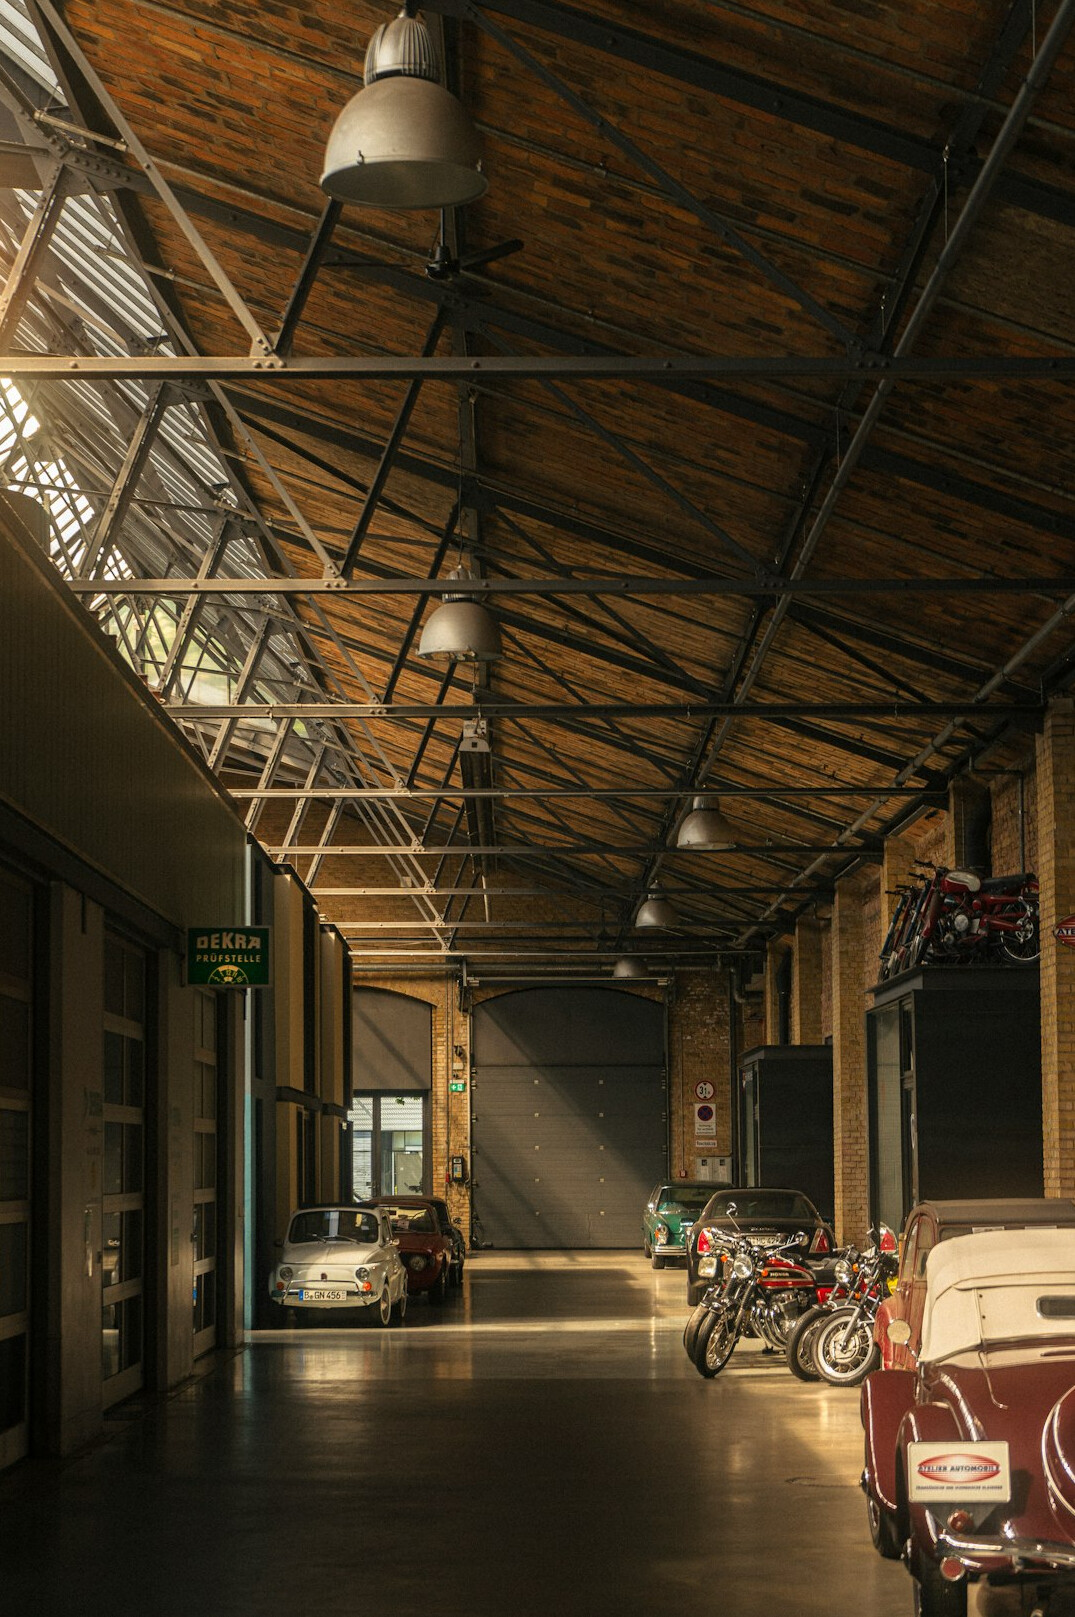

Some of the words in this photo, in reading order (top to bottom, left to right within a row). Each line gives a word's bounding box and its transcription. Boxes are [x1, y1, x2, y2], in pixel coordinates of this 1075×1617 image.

[196, 931, 261, 949] DEKRA
[196, 952, 261, 963] PRÜFSTELLE
[304, 1291, 310, 1300] B
[314, 1291, 325, 1300] GN
[326, 1291, 341, 1300] 456
[918, 1465, 948, 1473] ATELIER
[950, 1465, 1001, 1473] AUTOMOBILE
